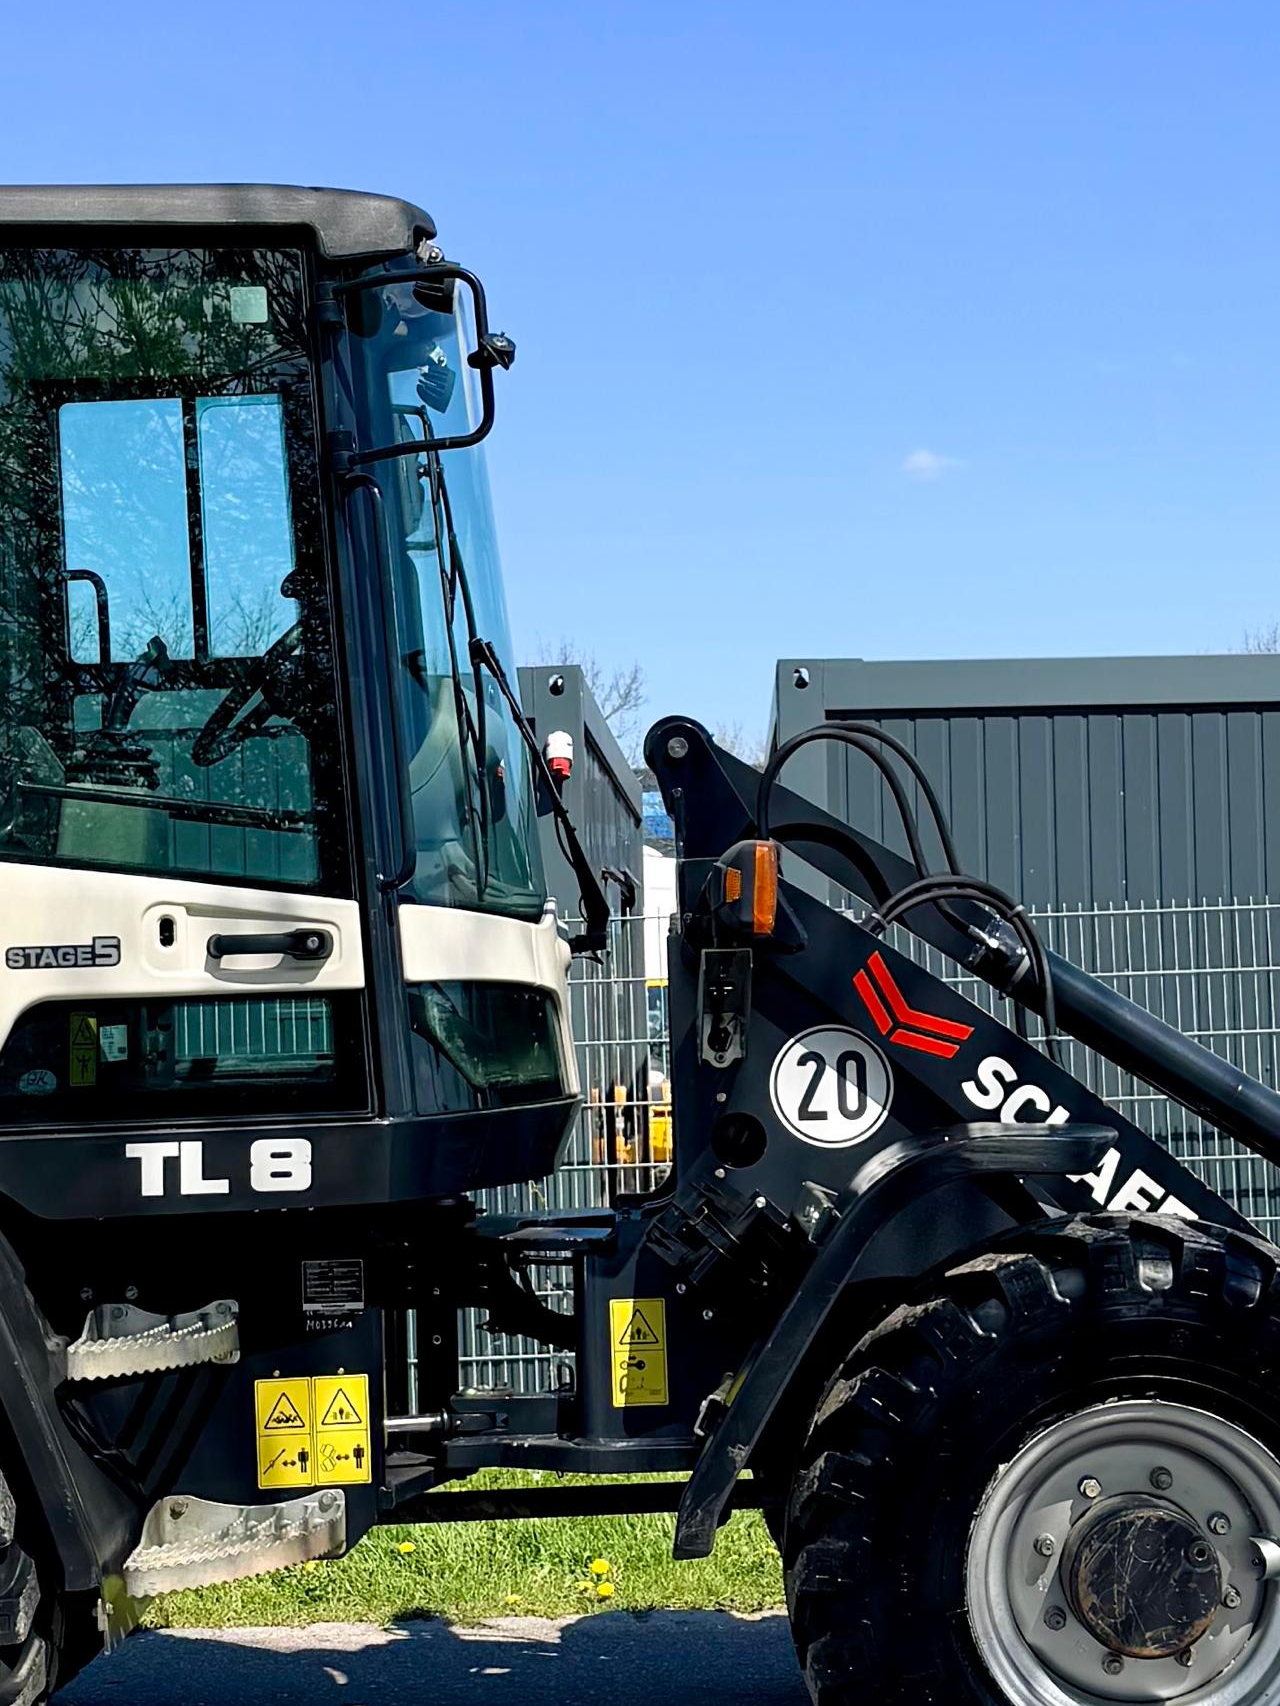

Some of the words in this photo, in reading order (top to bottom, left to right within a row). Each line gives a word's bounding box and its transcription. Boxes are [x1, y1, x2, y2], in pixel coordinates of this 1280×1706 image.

[796, 1050, 868, 1122] 20
[125, 1140, 230, 1197] TL
[250, 1138, 312, 1193] 8
